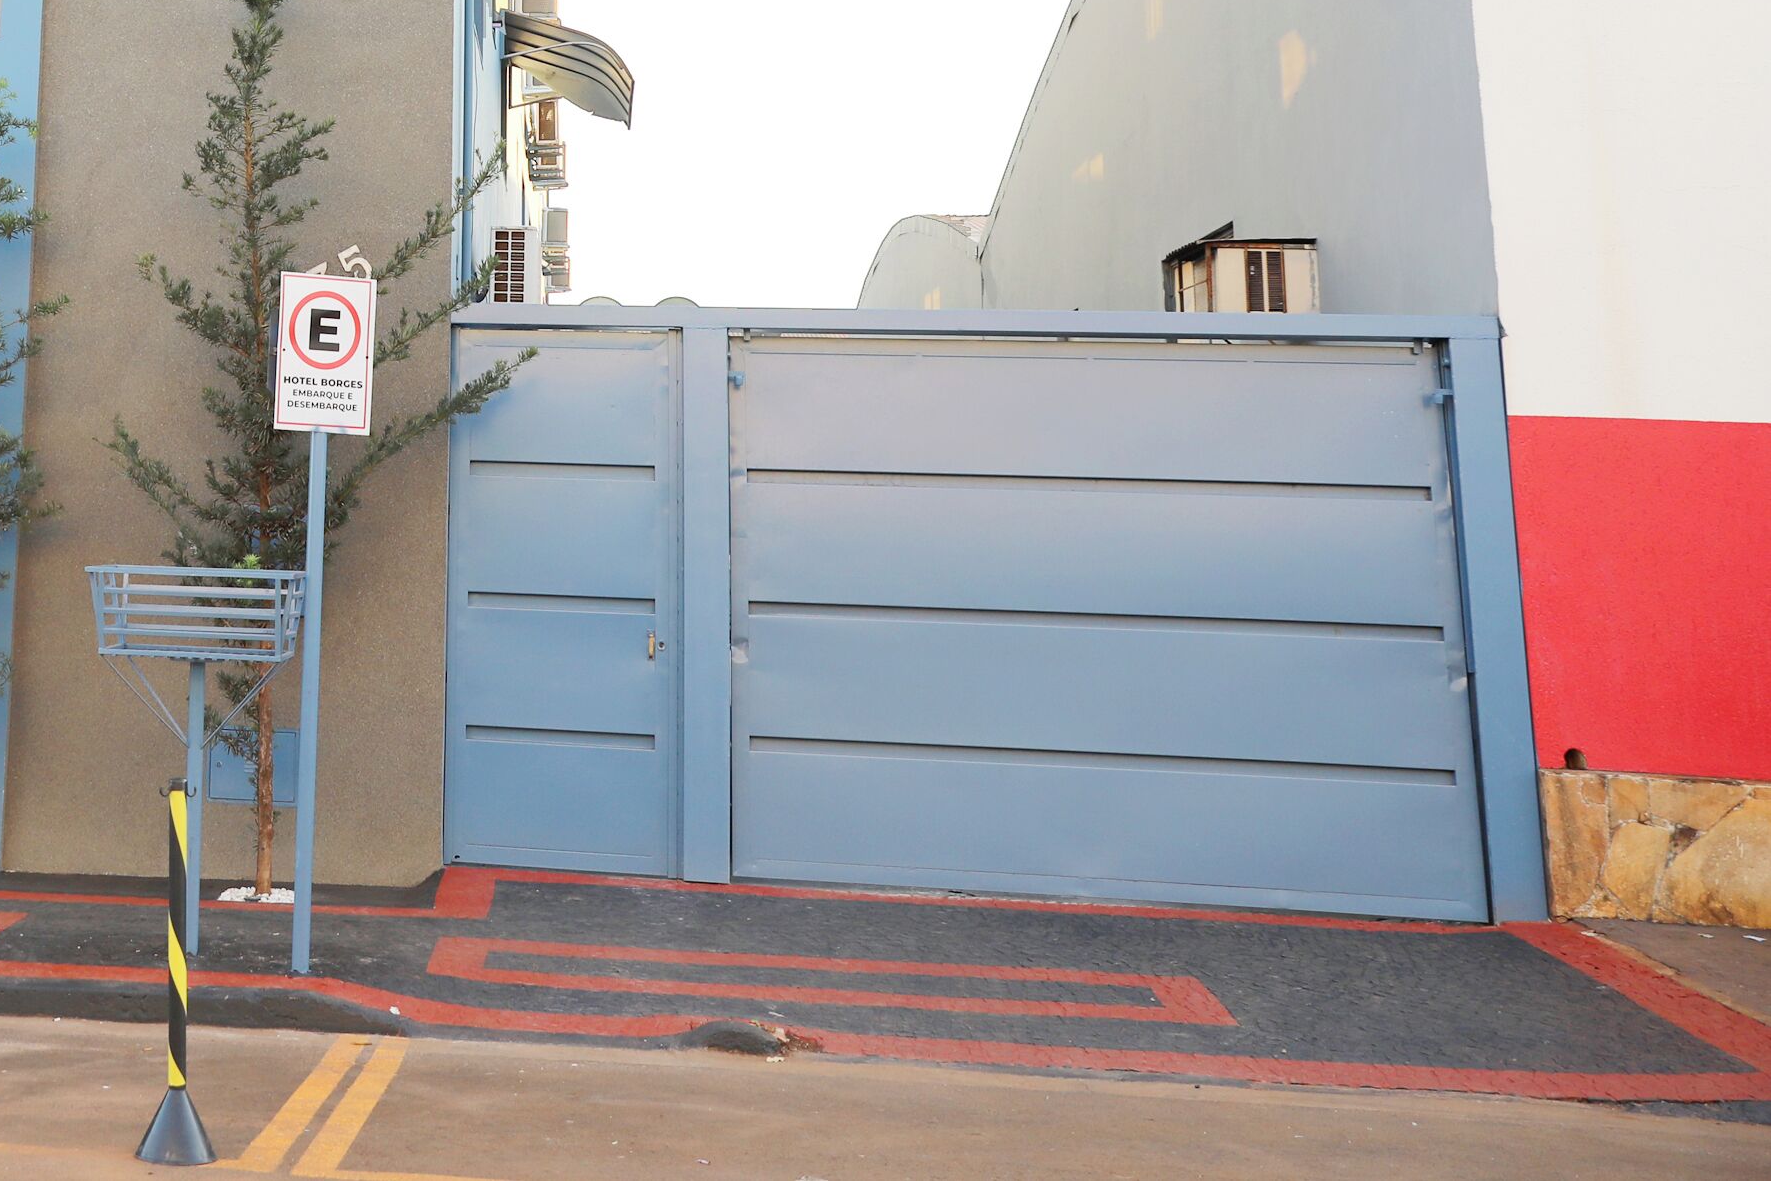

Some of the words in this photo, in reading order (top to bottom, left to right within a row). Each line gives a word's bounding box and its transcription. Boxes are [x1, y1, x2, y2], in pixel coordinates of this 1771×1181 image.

[308, 308, 341, 352] E
[283, 376, 318, 386] HOTEL
[321, 378, 363, 389] BORGES
[292, 388, 345, 400] EMBARQUE
[347, 391, 353, 400] E
[287, 400, 358, 412] DESEMBARQUE
